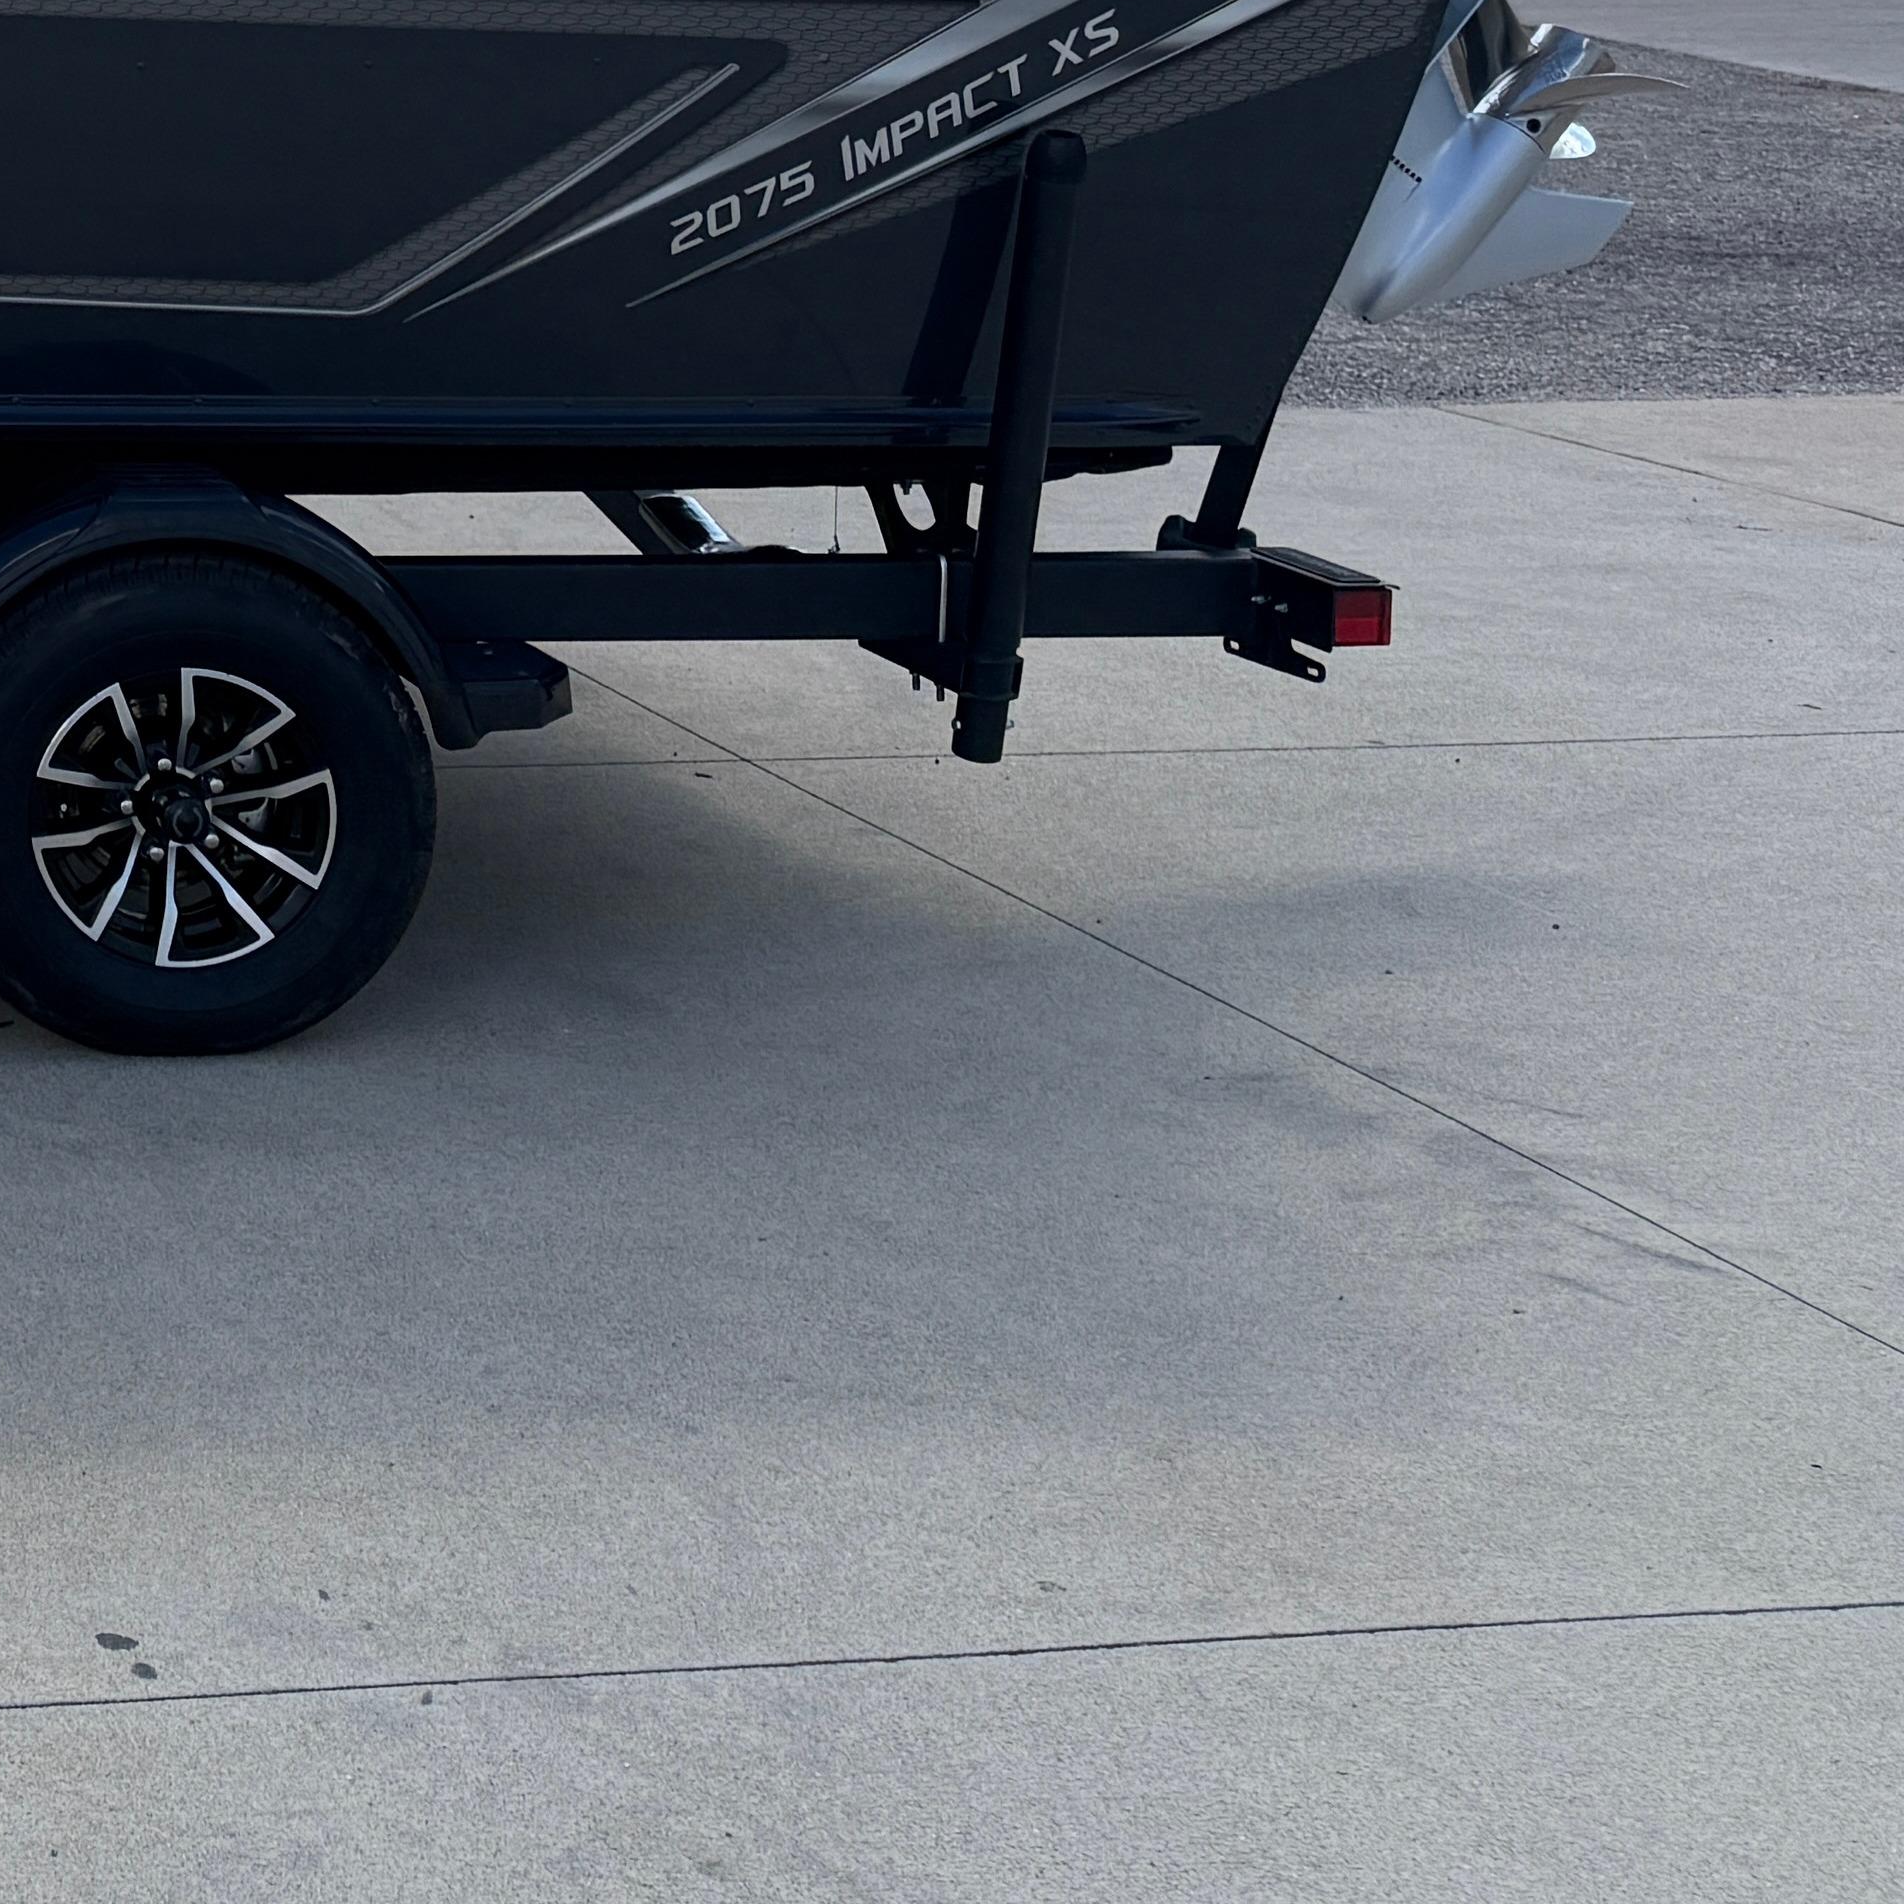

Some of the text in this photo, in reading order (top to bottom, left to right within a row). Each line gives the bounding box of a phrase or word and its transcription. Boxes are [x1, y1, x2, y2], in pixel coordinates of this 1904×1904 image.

[669, 8, 1120, 256] 2075 IMPACT XS
